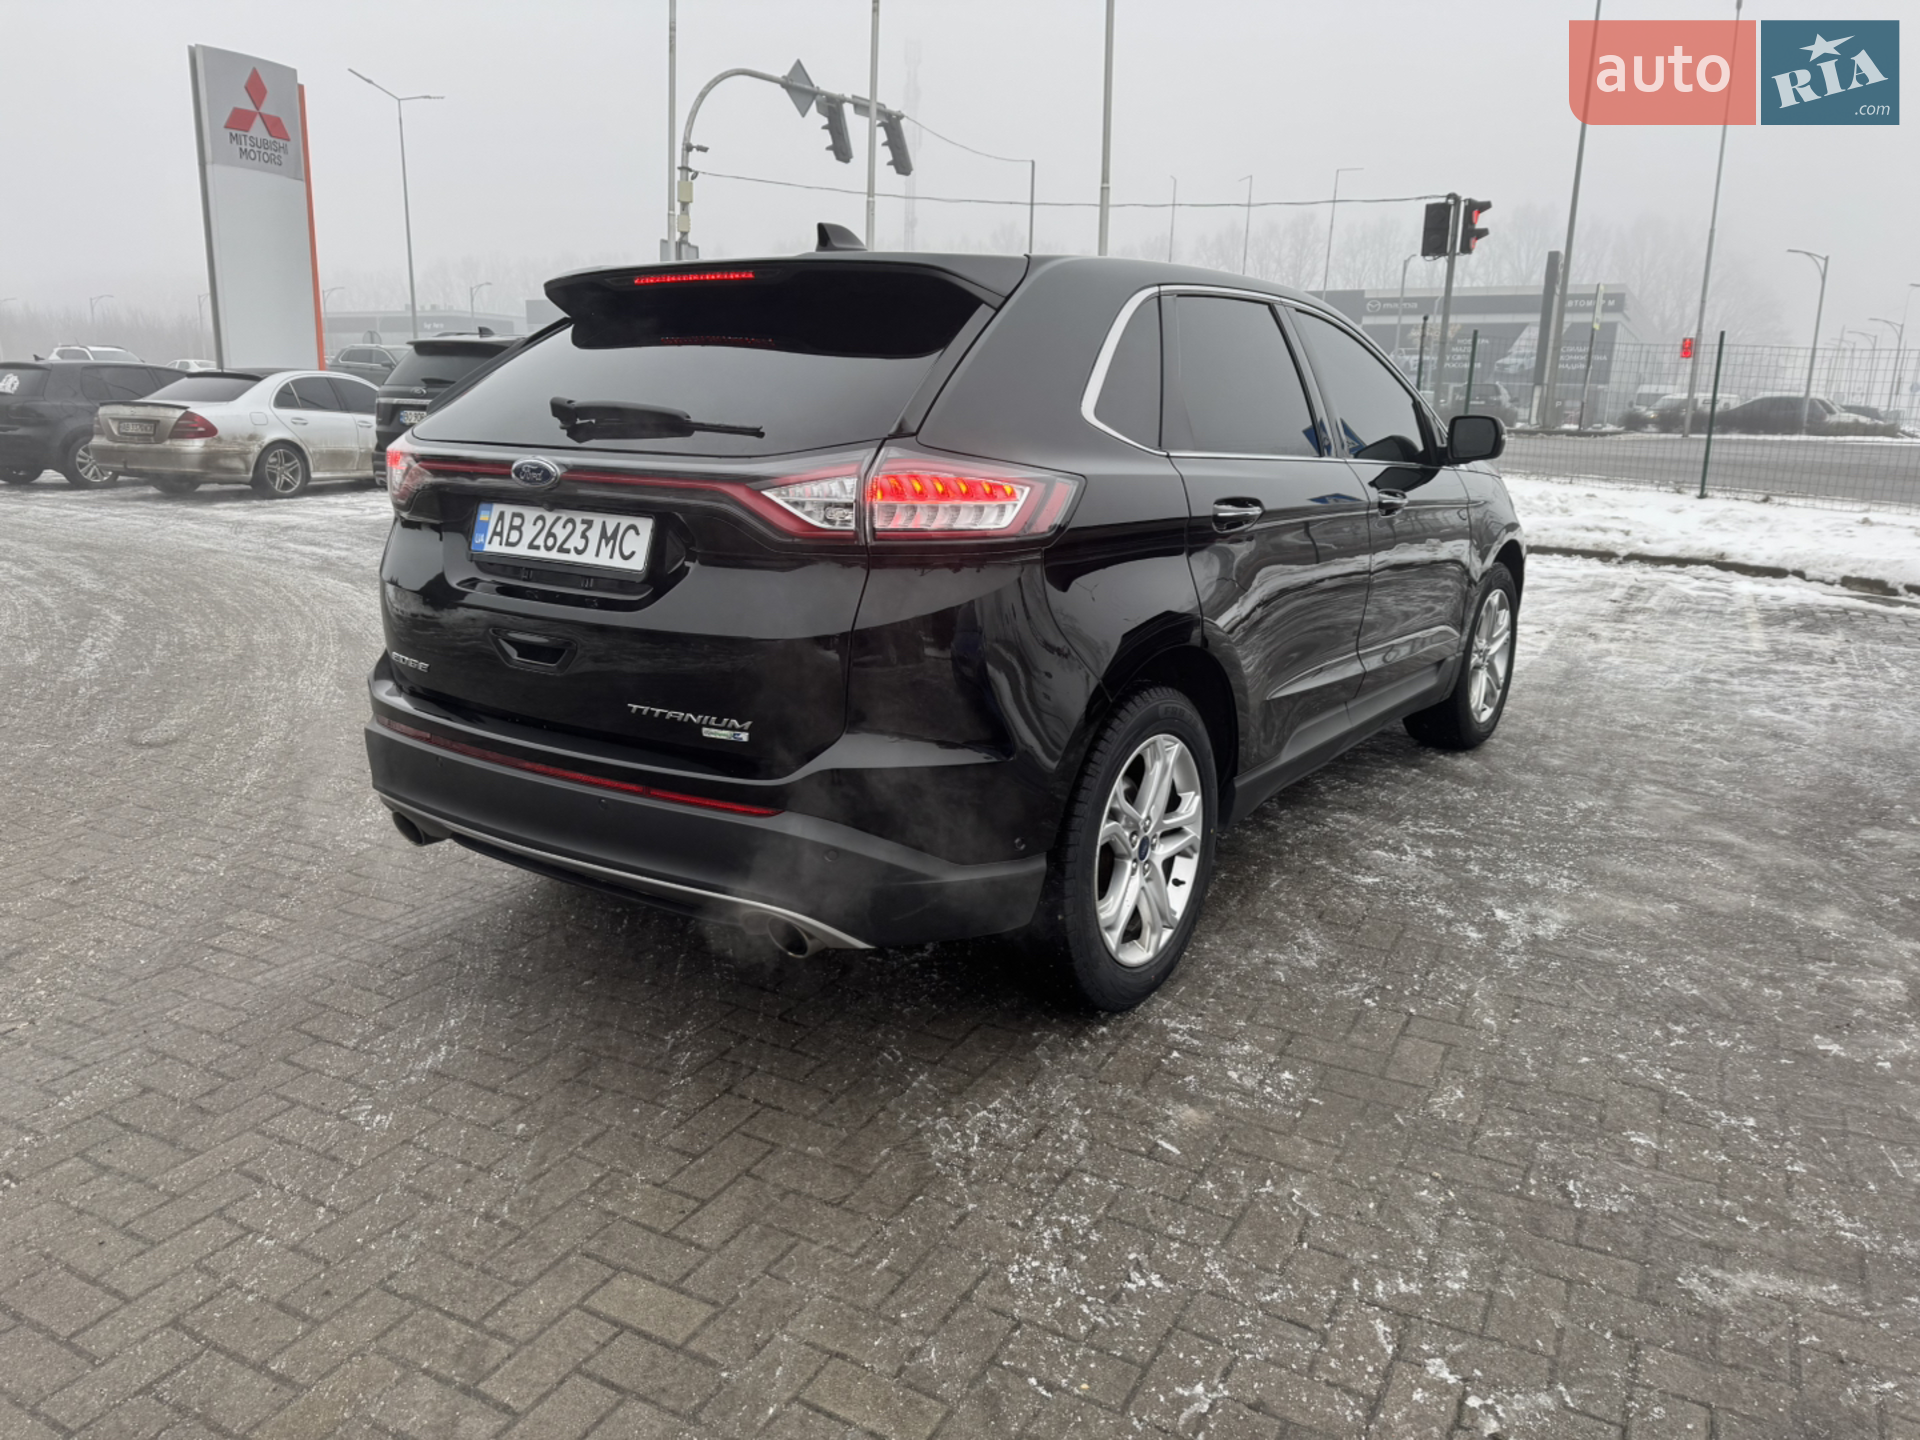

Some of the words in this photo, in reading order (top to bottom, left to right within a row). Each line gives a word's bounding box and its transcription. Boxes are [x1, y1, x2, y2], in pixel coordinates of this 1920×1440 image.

[228, 131, 289, 156] MITSUBISHI
[238, 146, 283, 167] MOTORS
[519, 464, 545, 481] Ford
[487, 510, 526, 548] AB
[527, 514, 595, 556] 2623
[594, 519, 641, 561] MC
[391, 651, 430, 673] EDGE
[627, 703, 753, 731] TITANIUM
